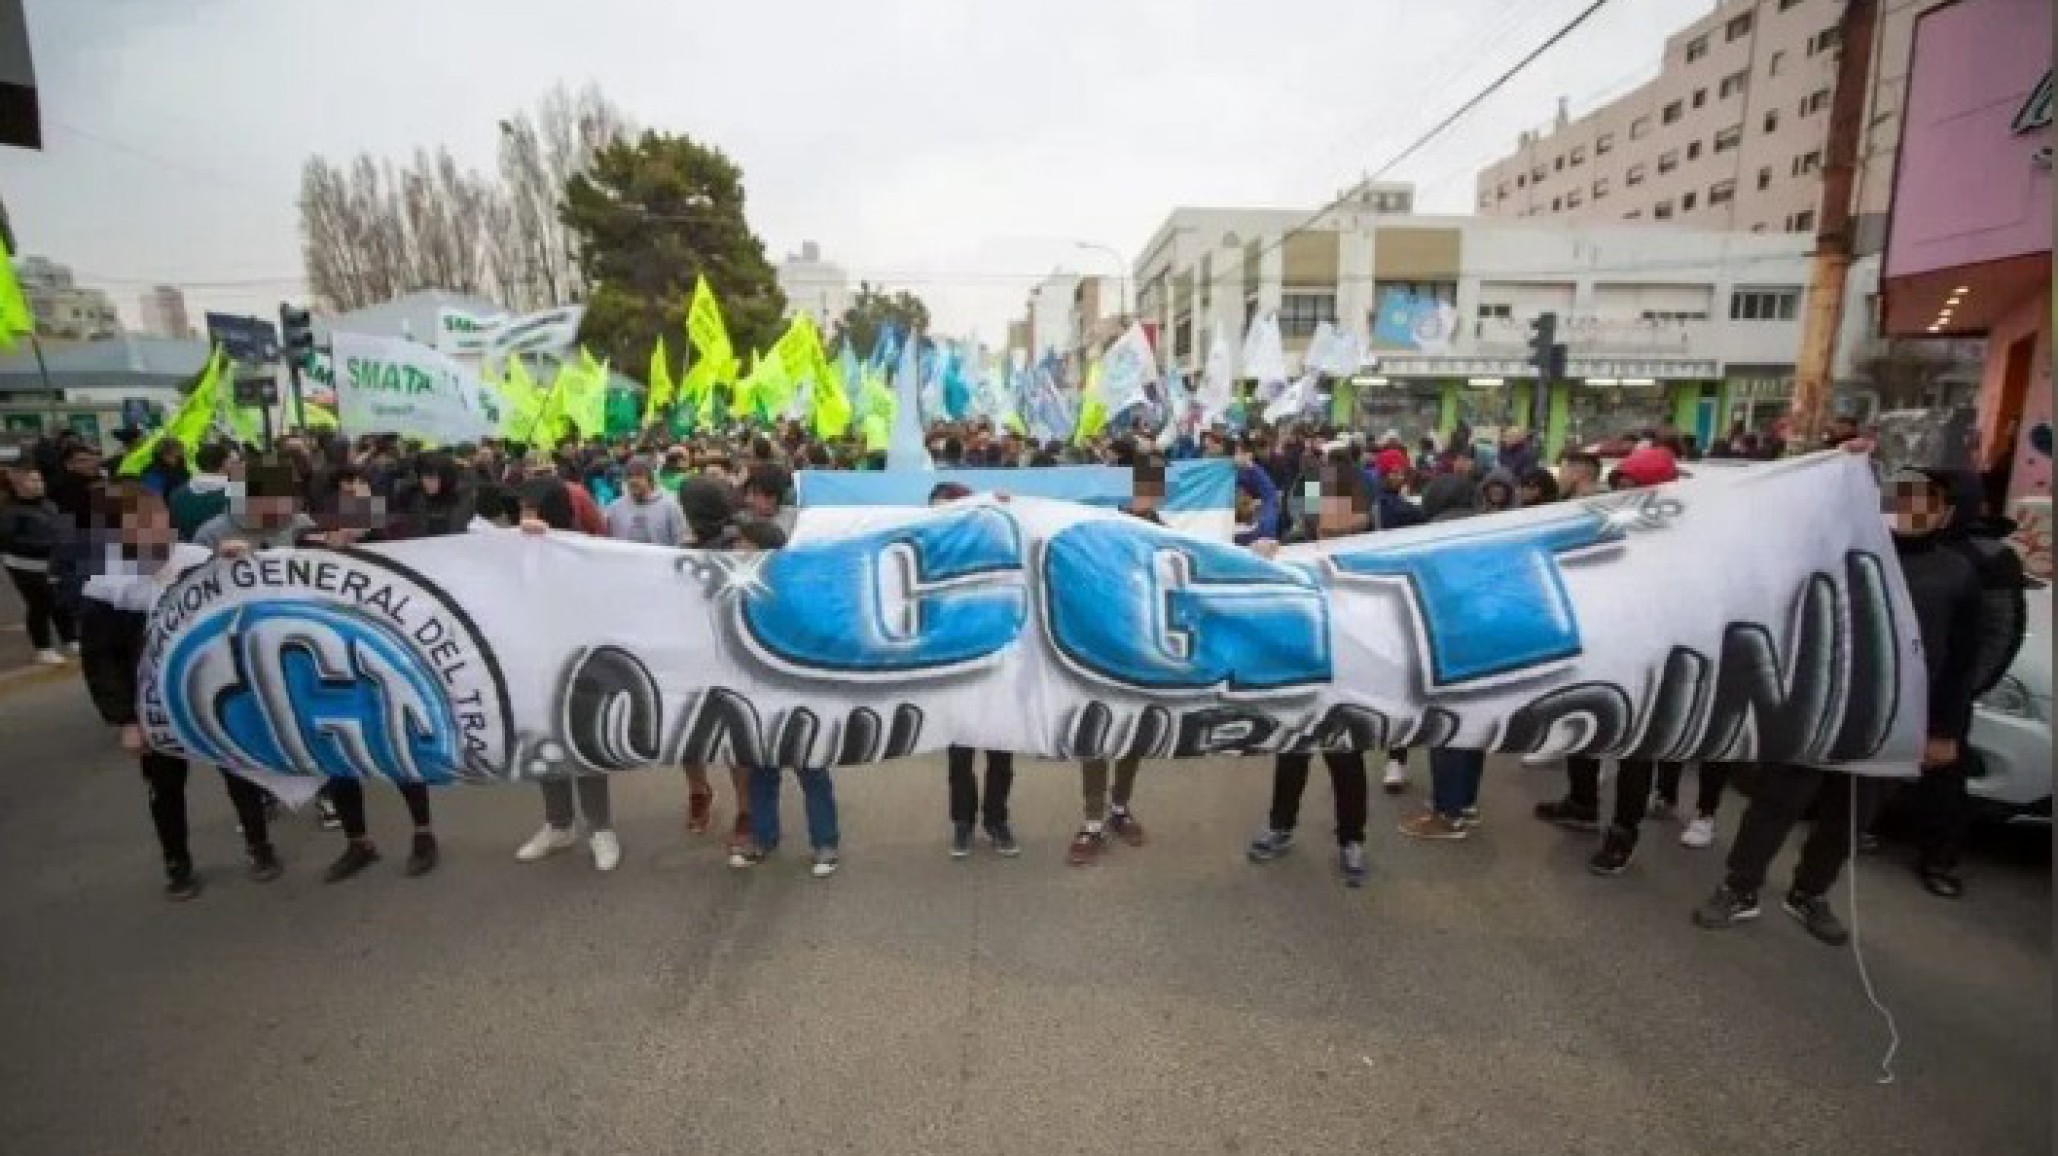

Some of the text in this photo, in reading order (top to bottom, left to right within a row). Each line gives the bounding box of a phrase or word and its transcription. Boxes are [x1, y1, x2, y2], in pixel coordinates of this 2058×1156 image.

[346, 356, 435, 395] SMATA
[230, 558, 410, 626] GENERAL
[414, 617, 467, 686] DEL
[740, 503, 1628, 692] CGT
